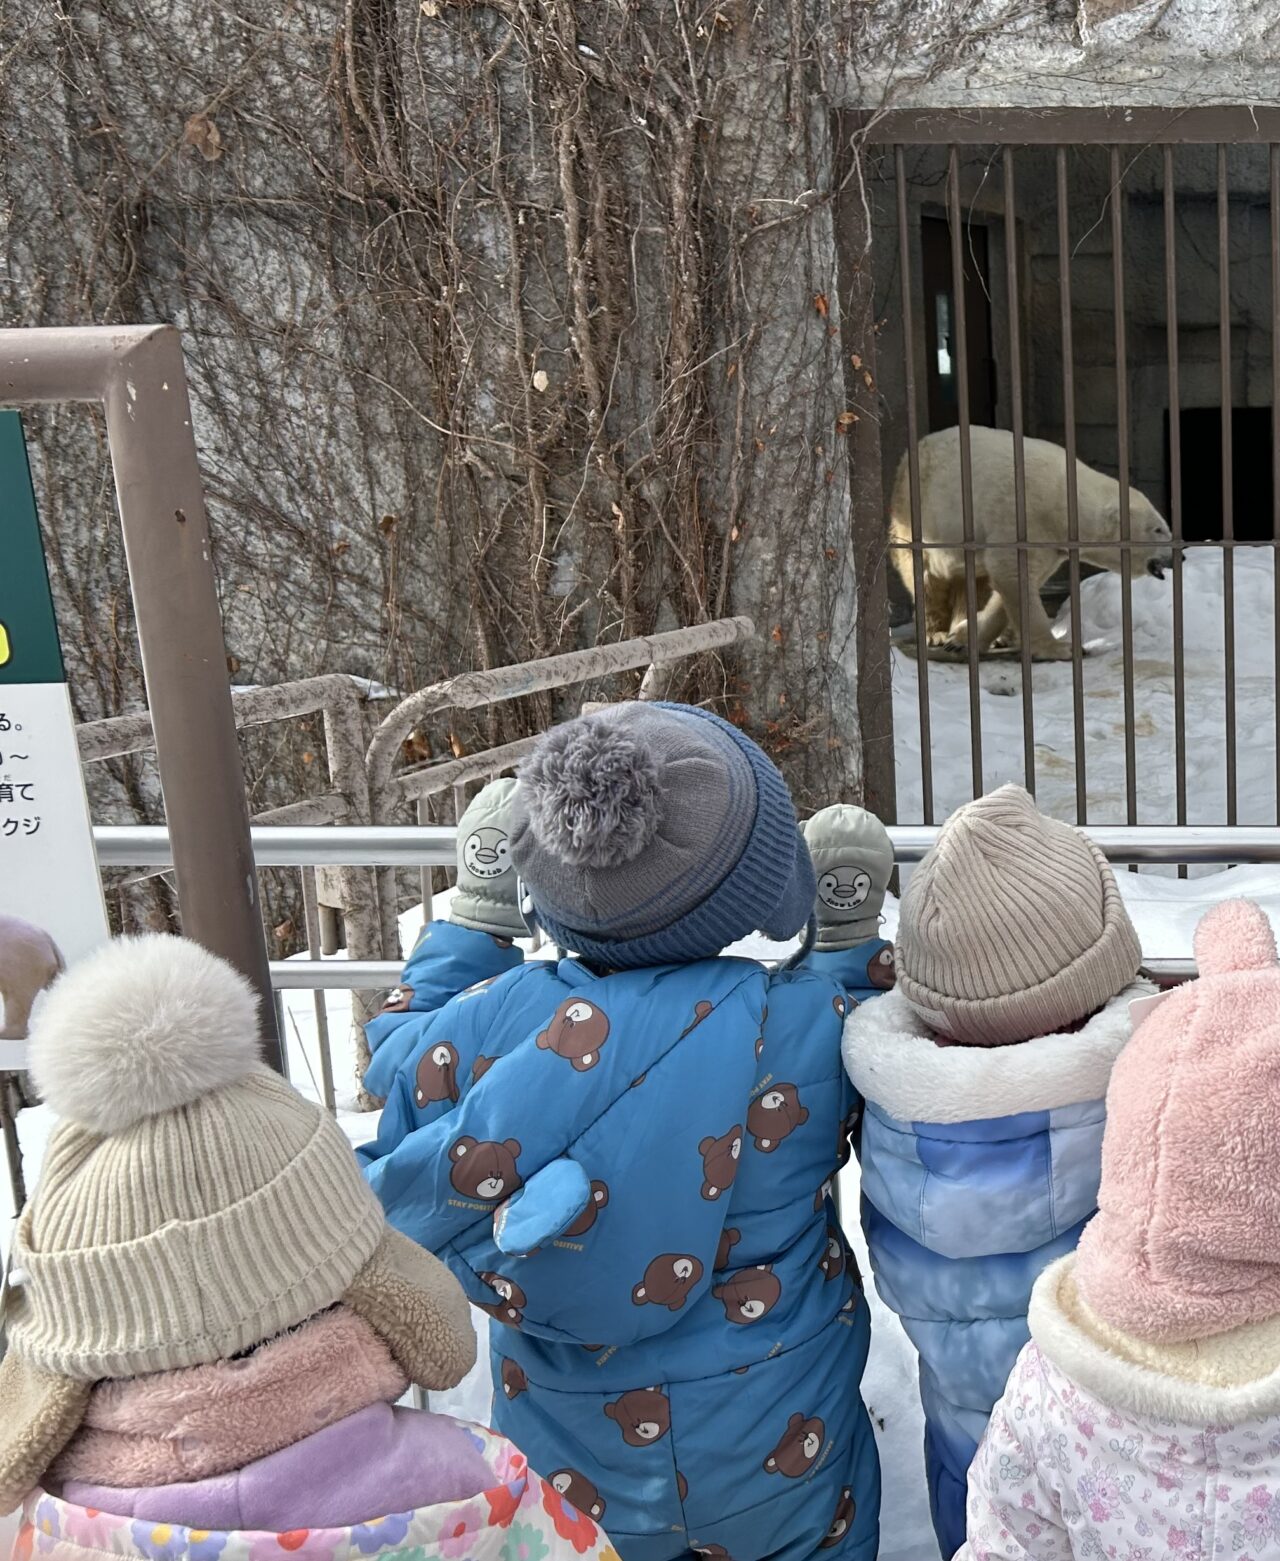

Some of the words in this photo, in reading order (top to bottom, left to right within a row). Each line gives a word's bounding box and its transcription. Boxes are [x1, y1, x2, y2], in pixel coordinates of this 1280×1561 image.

[469, 862, 485, 875] Snow
[826, 898, 845, 907] Snow
[847, 899, 861, 907] Lab
[447, 1199, 466, 1208] STAY
